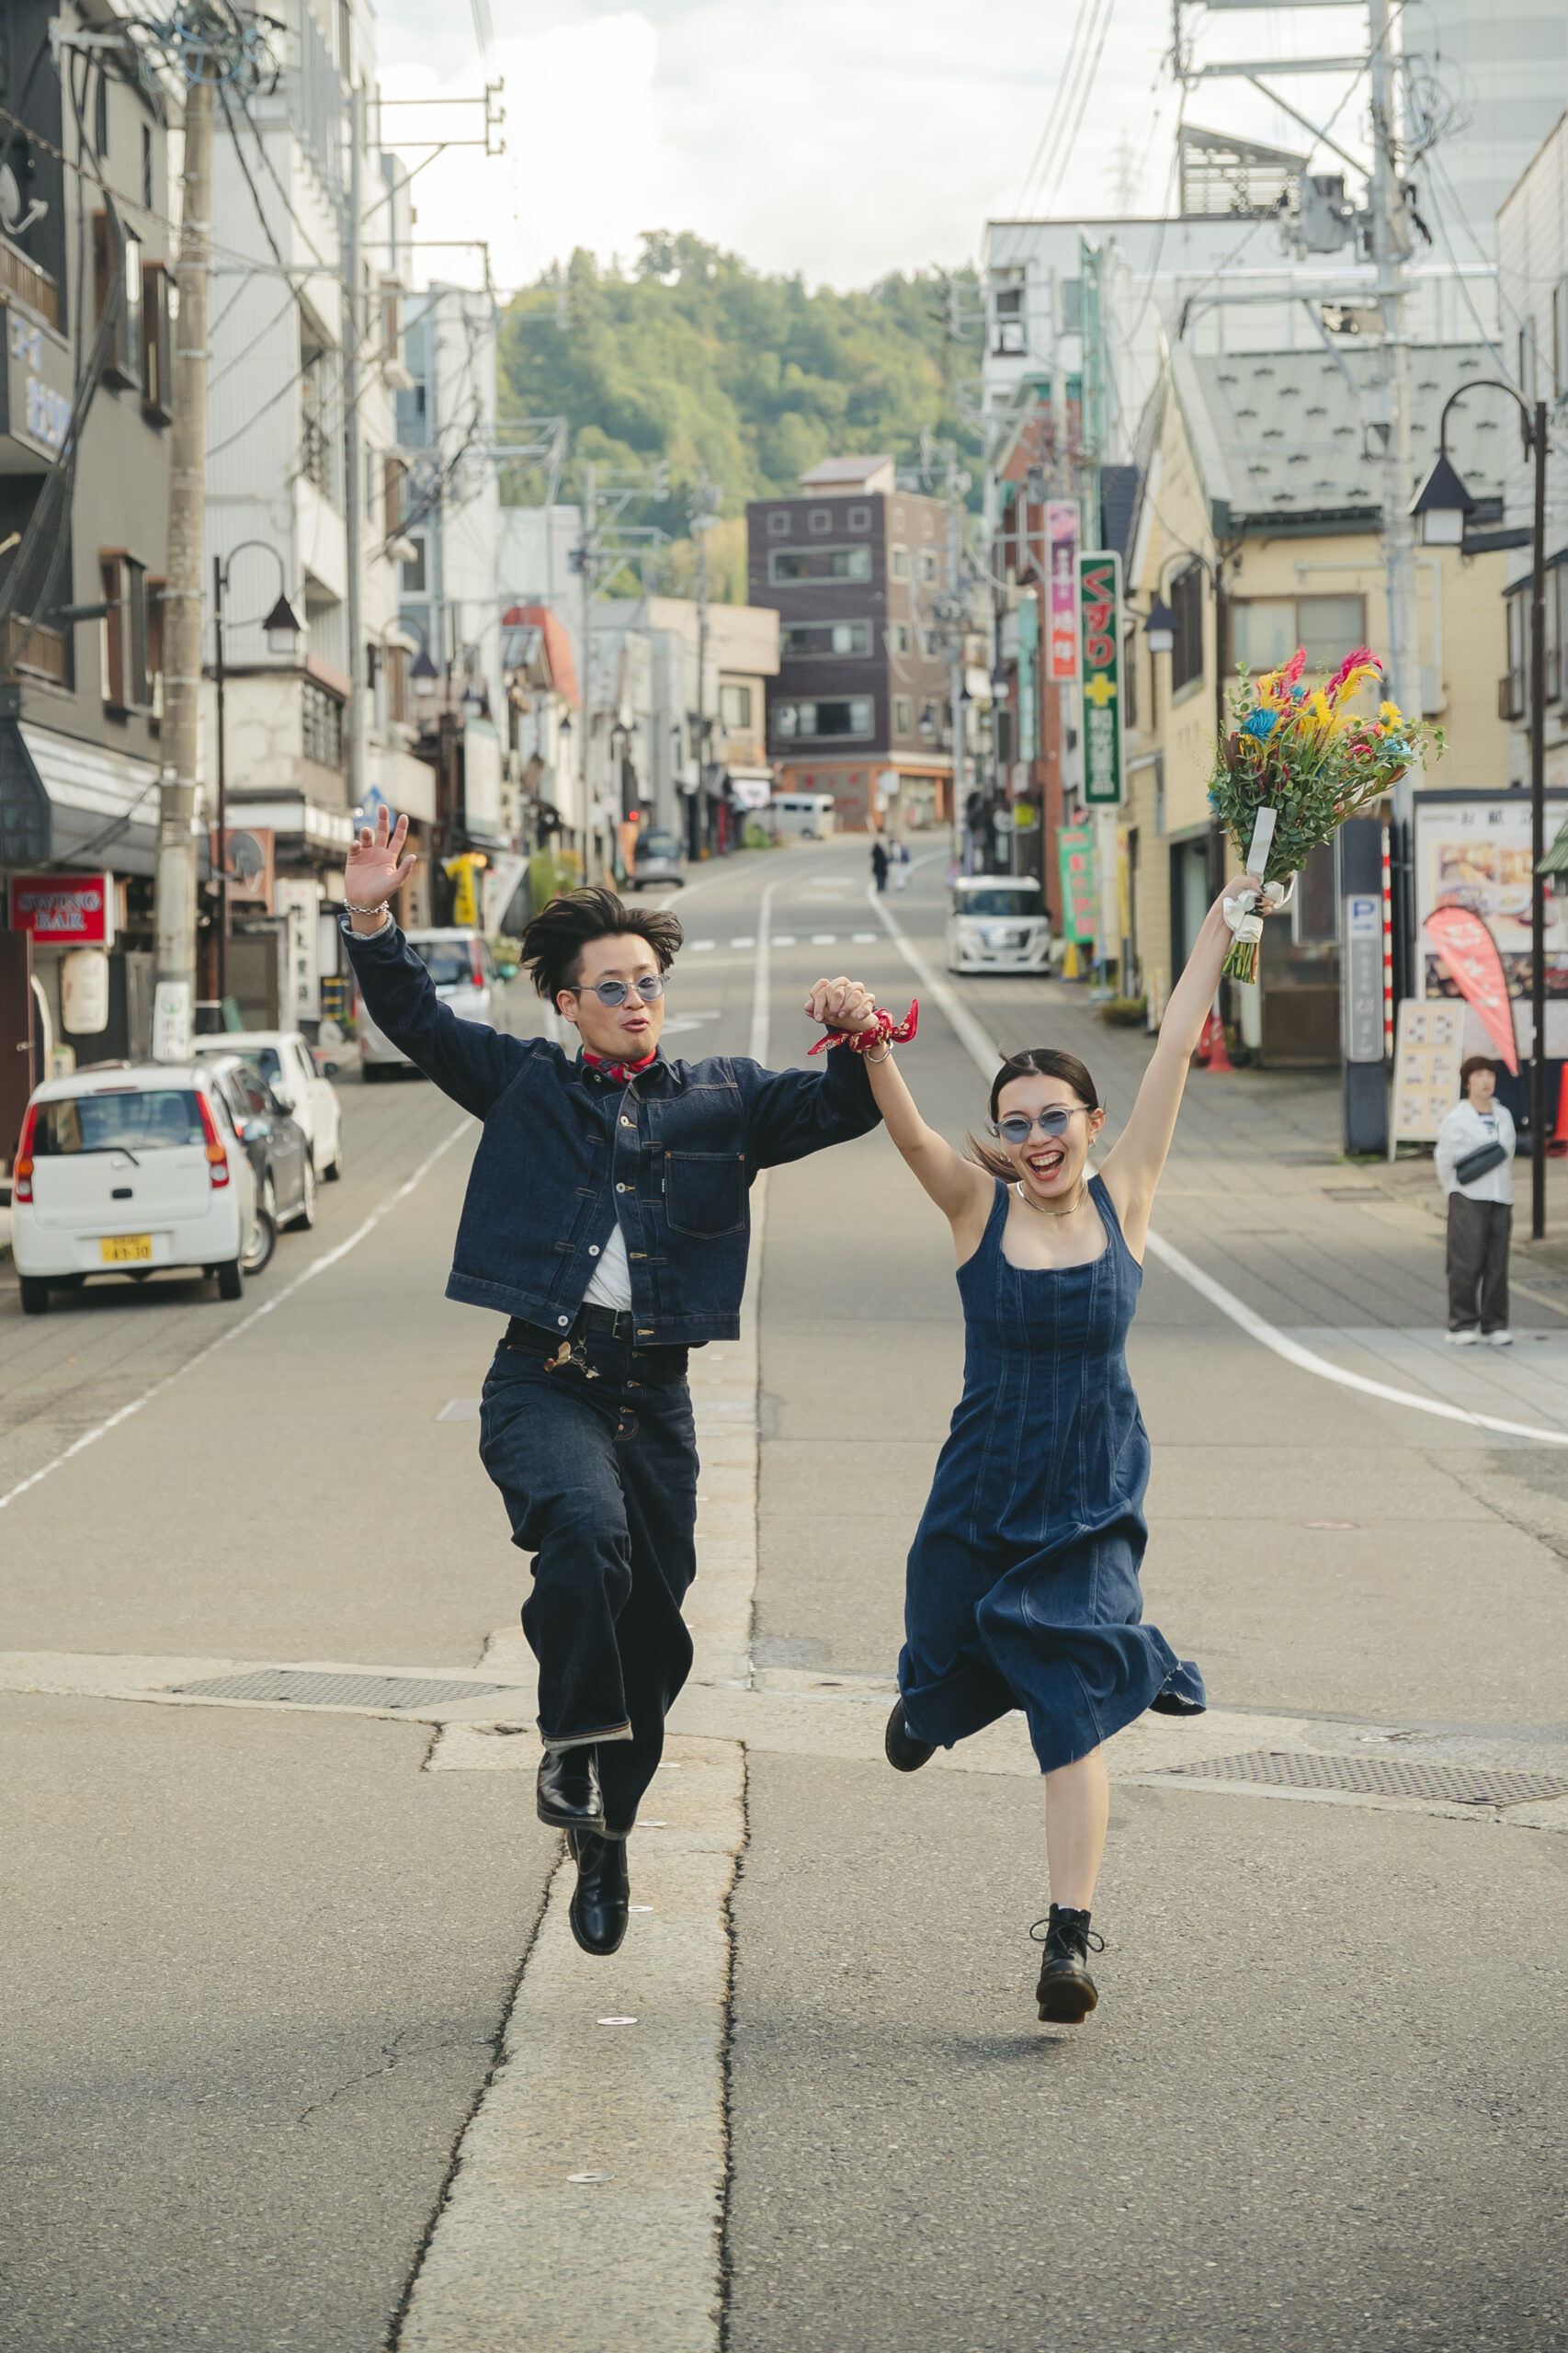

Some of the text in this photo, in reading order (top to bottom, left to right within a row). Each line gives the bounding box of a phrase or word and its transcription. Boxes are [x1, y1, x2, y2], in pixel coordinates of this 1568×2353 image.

[1083, 564, 1115, 668] くすり
[19, 891, 101, 912] SWING
[1353, 900, 1375, 918] P
[35, 912, 87, 931] BAR
